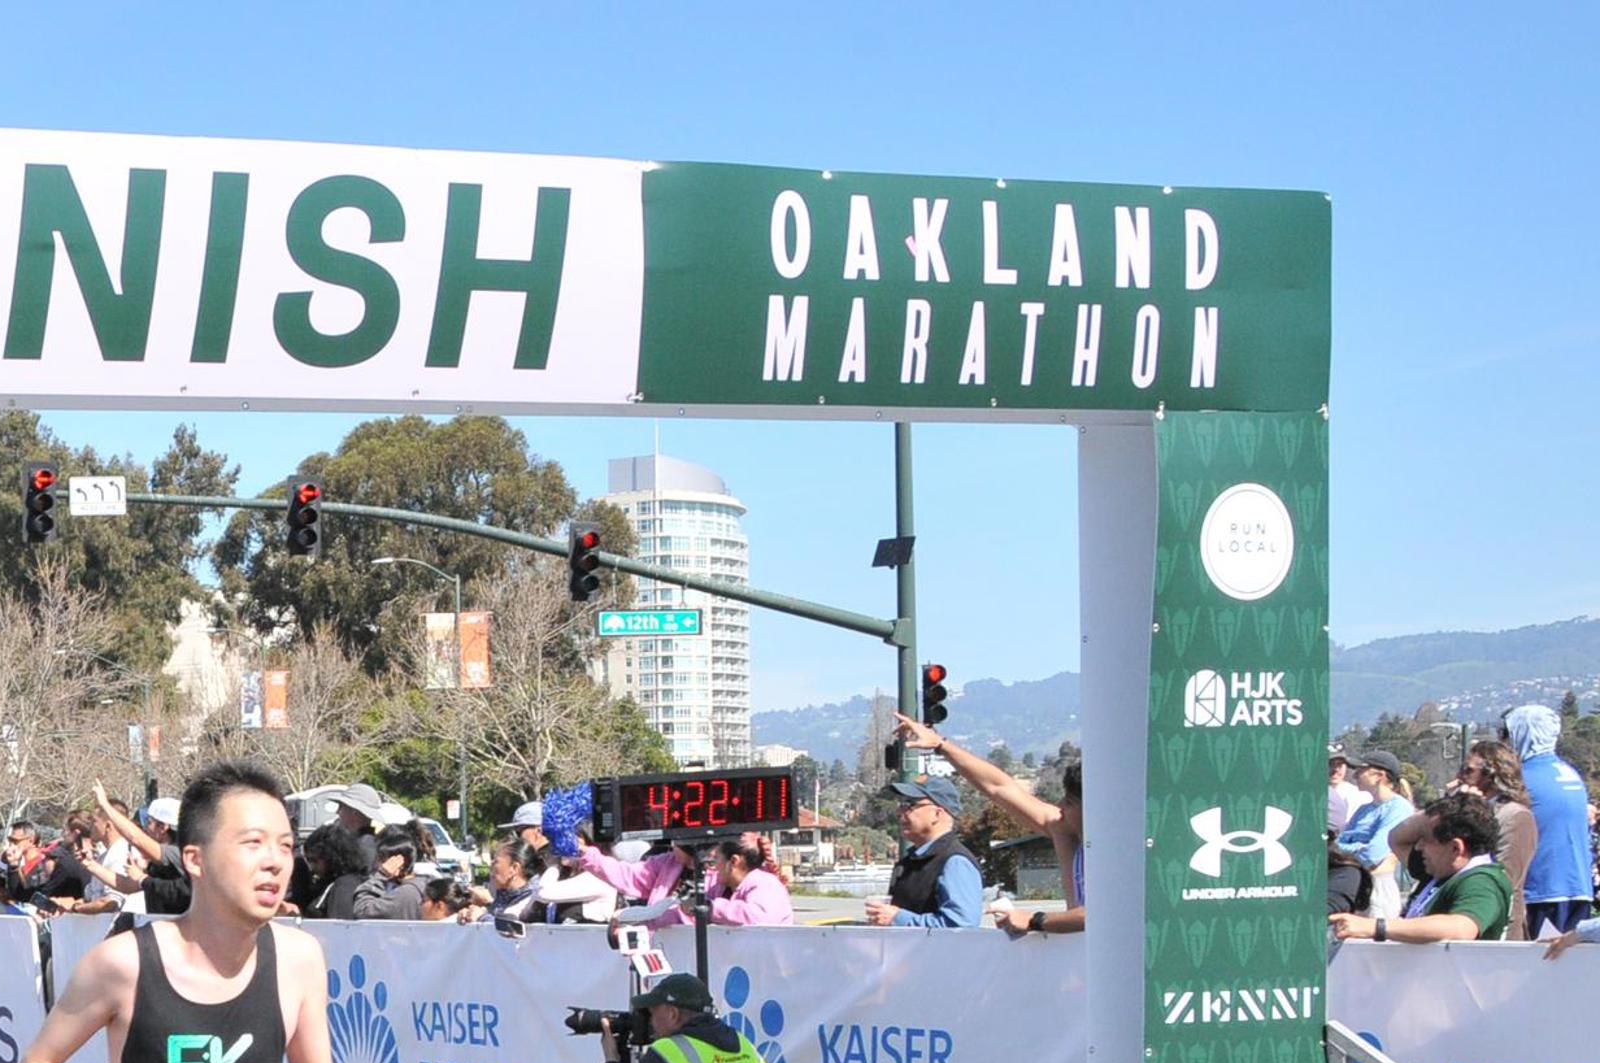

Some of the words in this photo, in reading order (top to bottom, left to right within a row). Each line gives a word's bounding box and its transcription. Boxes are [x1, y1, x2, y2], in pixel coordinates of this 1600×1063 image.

[770, 190, 1219, 290] OAKLAND
[762, 294, 1219, 388] MARATHON
[1230, 522, 1267, 535] RUN
[1219, 540, 1277, 553] LOCAL
[626, 614, 659, 630] 12th
[1230, 671, 1286, 698] HJK
[1230, 699, 1303, 726] ARTS
[1182, 887, 1235, 900] UNDER
[1164, 987, 1312, 1024] ZENNI
[412, 1001, 500, 1048] KAISER
